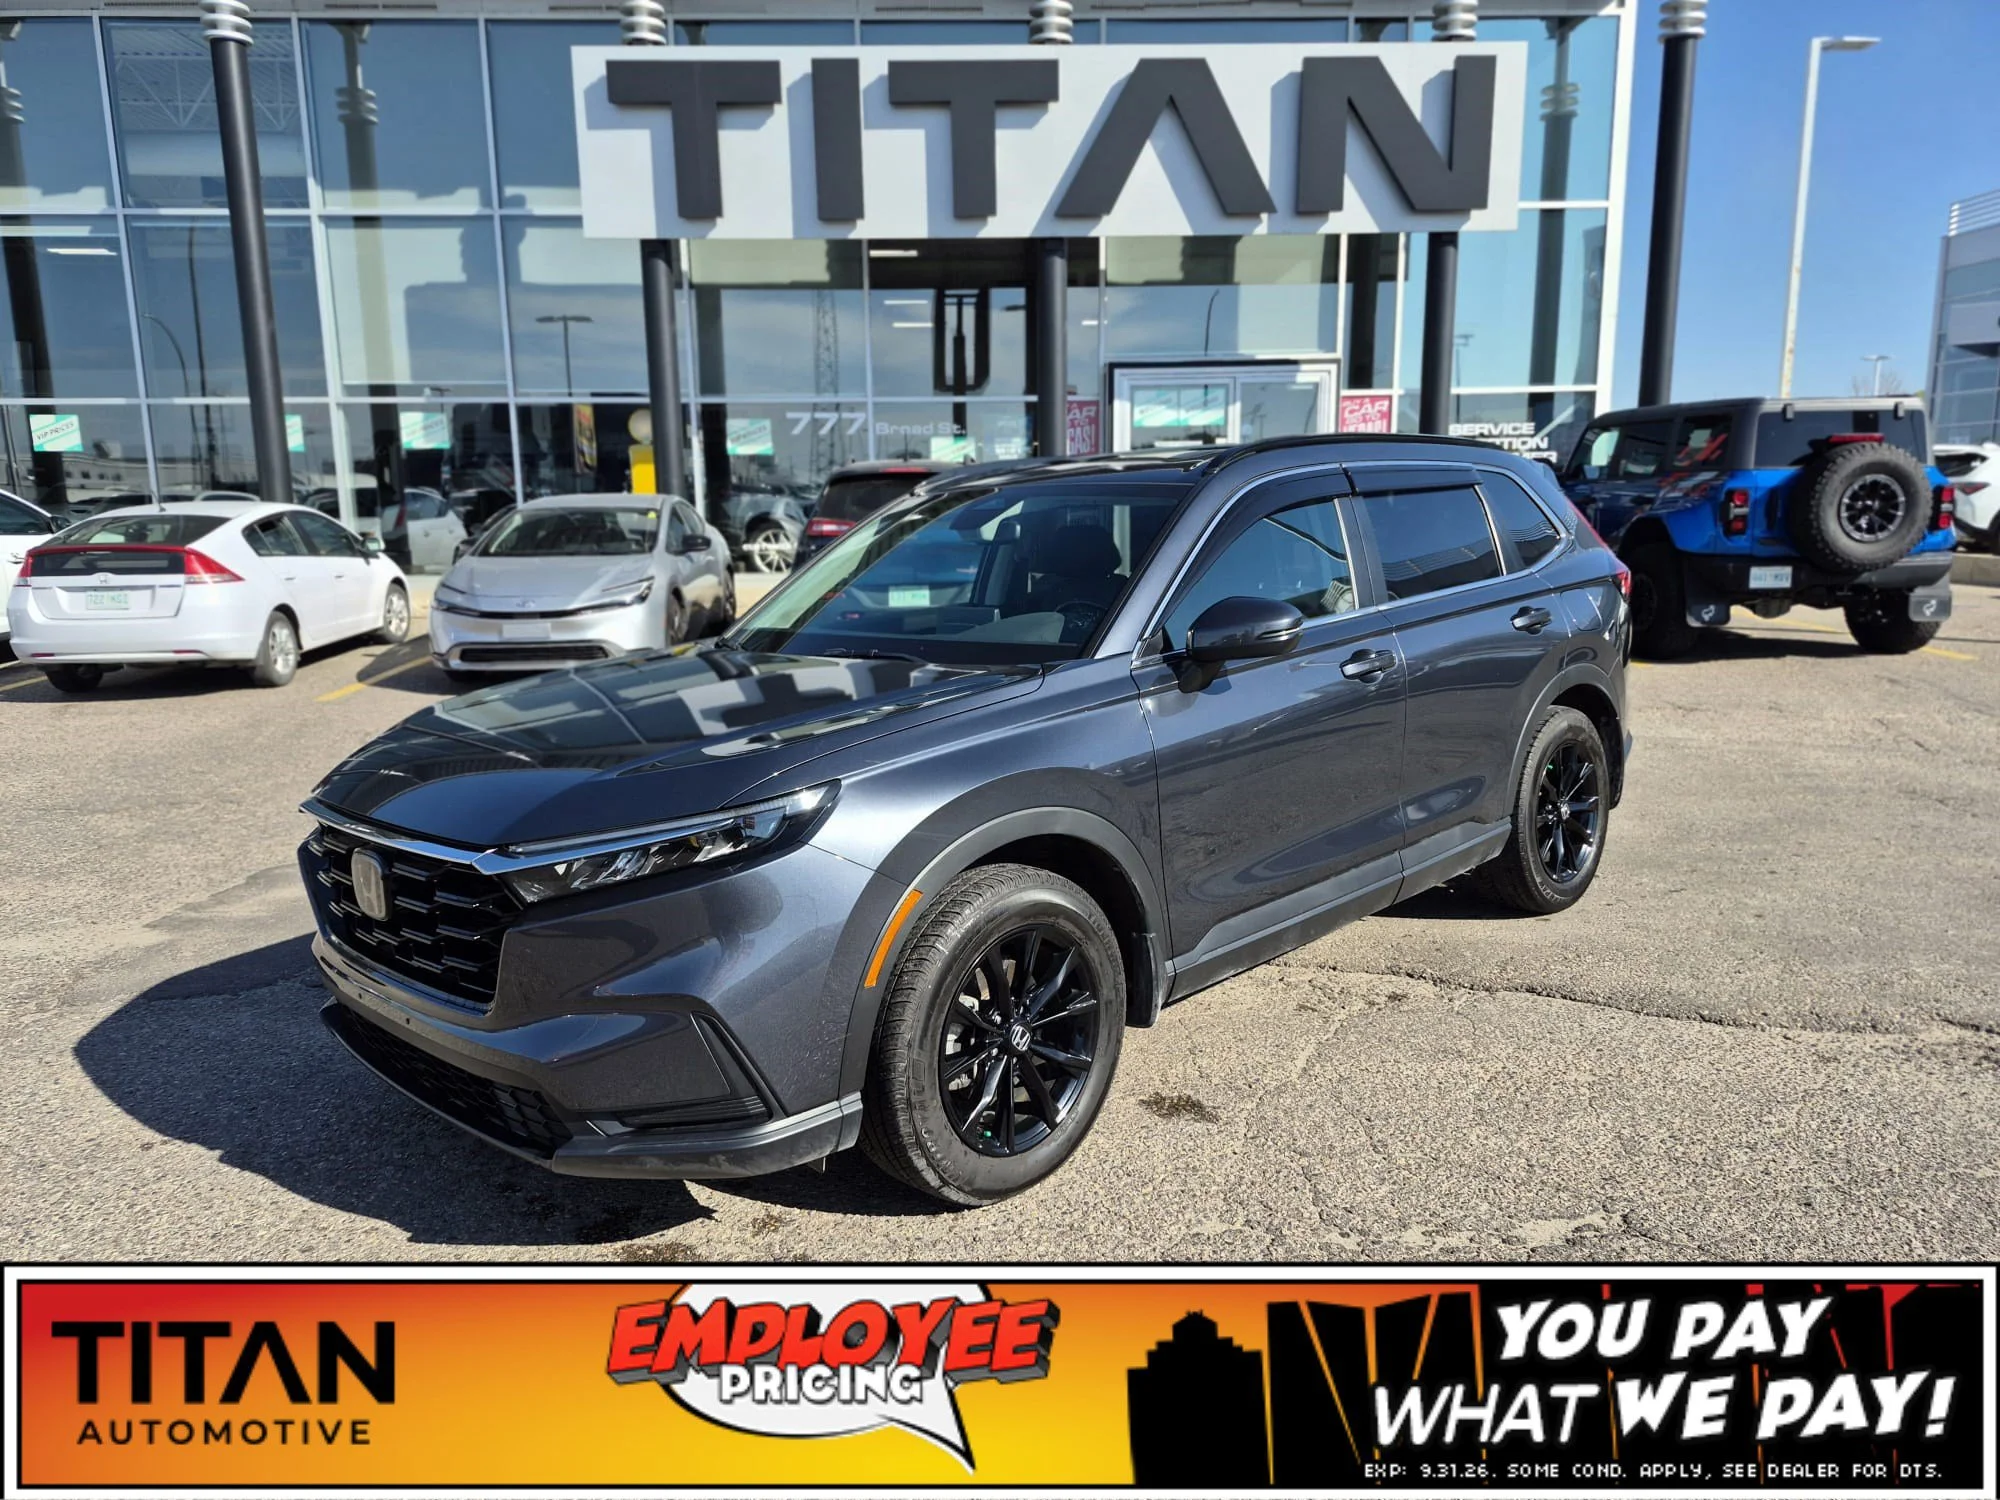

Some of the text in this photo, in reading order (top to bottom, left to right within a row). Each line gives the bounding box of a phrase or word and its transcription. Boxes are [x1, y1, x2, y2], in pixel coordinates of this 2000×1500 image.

[606, 54, 1497, 221] TITAN
[785, 412, 867, 435] 777
[1448, 422, 1536, 436] SERVICE
